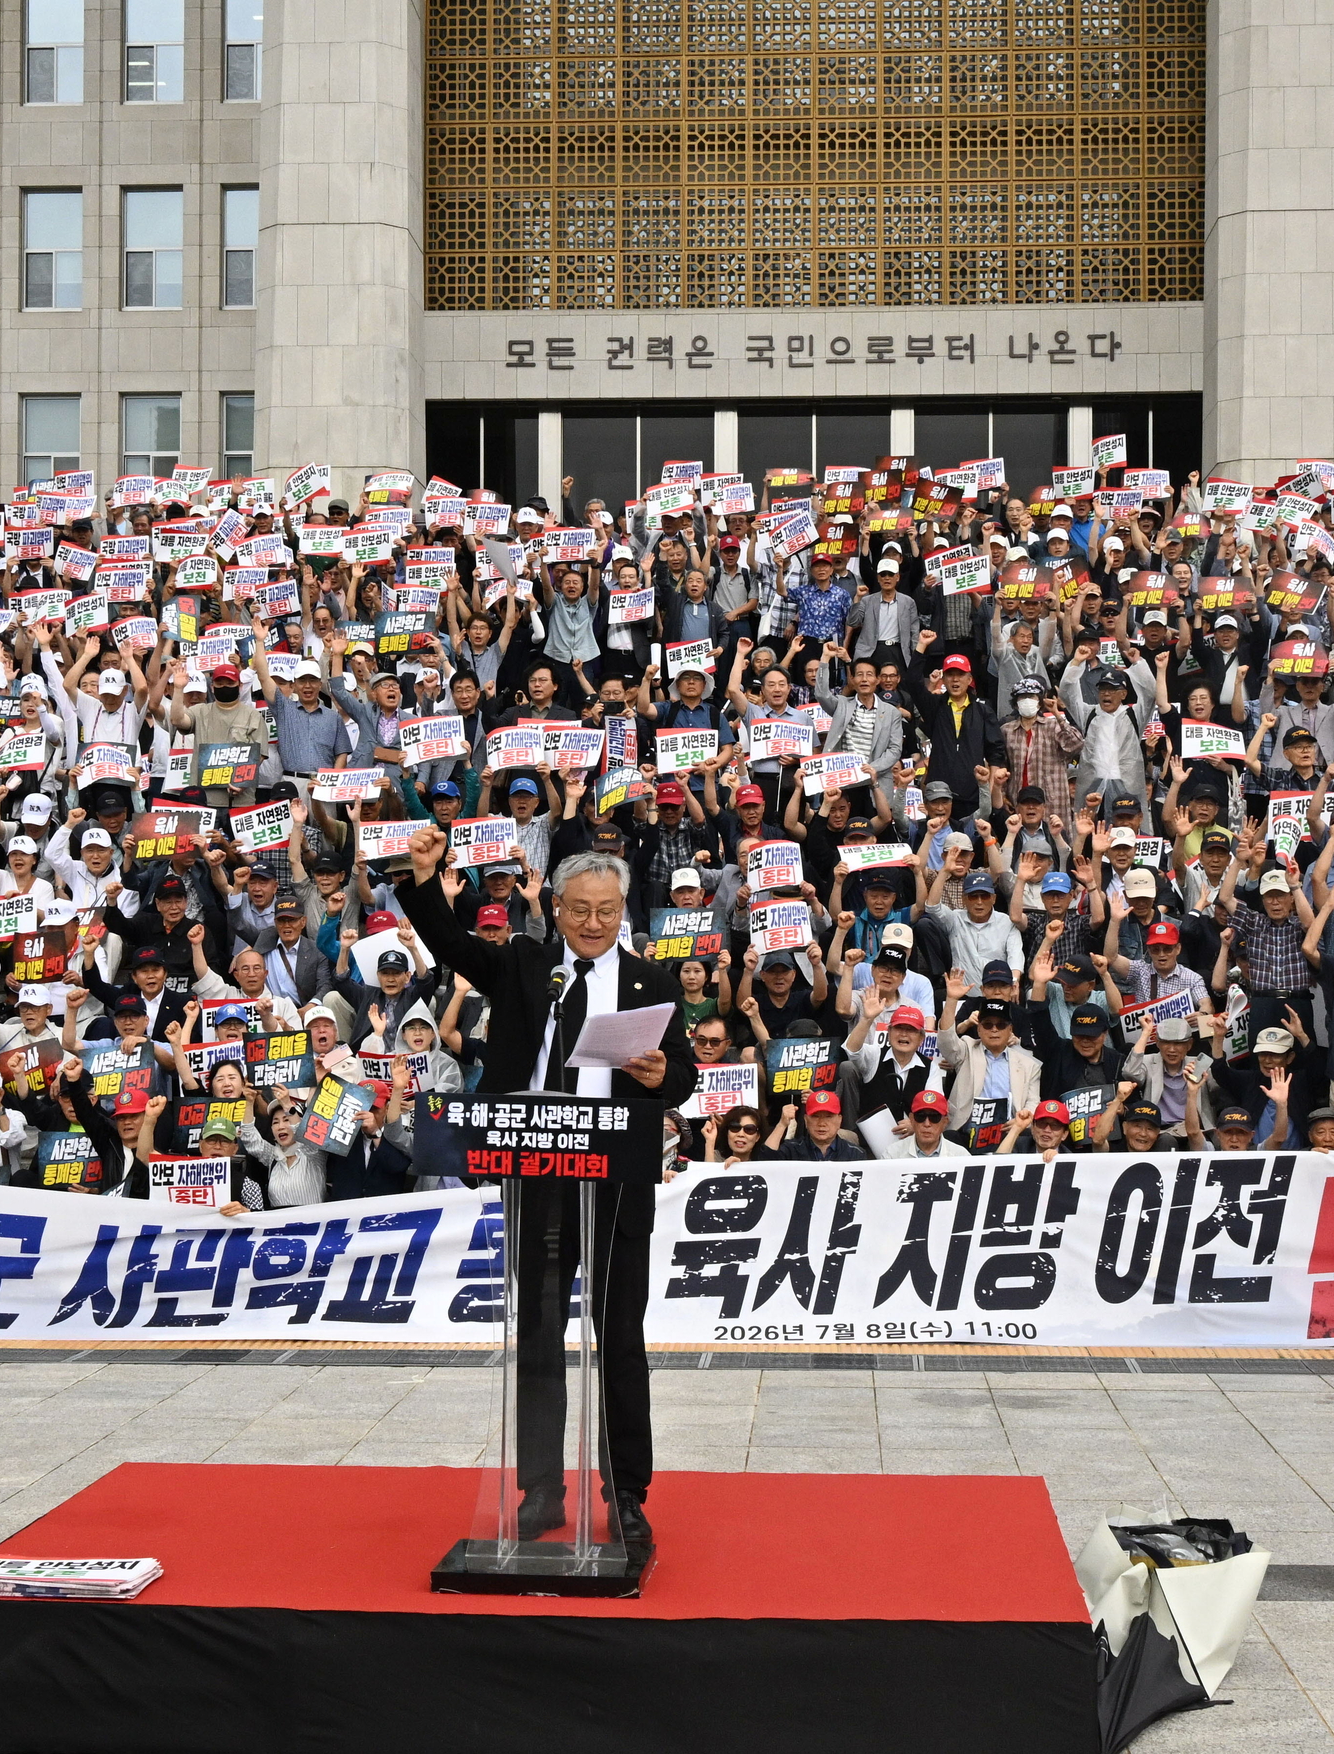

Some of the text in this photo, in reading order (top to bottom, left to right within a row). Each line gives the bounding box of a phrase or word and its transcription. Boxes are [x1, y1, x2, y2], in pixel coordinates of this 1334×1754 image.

[506, 331, 1121, 370] 모든 권력은 국민으로부터 나온다
[944, 558, 987, 577] 태릉 안보성지
[956, 574, 978, 588] 보존
[402, 719, 461, 746] 안보 자해행위
[660, 734, 716, 752] 태릉 자연환경
[209, 746, 251, 766] 사관학교
[421, 741, 448, 756] 중단
[675, 751, 704, 767] 보전
[201, 764, 256, 785] 통폐합 반대
[235, 803, 290, 832] 태릉 자연환경
[253, 826, 283, 845] 보전
[454, 822, 514, 848] 안보 자해행위
[472, 844, 501, 860] 중단
[662, 912, 713, 935] 사관학교
[24, 937, 45, 958] 육사
[656, 933, 722, 959] 통폐합 반대
[27, 958, 43, 980] 이전
[45, 954, 64, 977] 반대
[448, 1102, 629, 1130] 육·해·공군 사관학교 통합
[1135, 1107, 1157, 1115] KMA
[487, 1131, 589, 1150] 육사 지방 이전
[152, 1162, 227, 1186] 안보 자해행위
[467, 1150, 608, 1177] 반대 궐기대회
[175, 1189, 208, 1205] 중단
[47, 1207, 444, 1328] 사관학교
[664, 1171, 864, 1319] 육사
[872, 1161, 1079, 1312] 지방
[1094, 1154, 1297, 1306] 이전
[714, 1321, 1037, 1340] 2026년 7월 8일(수) 11:00
